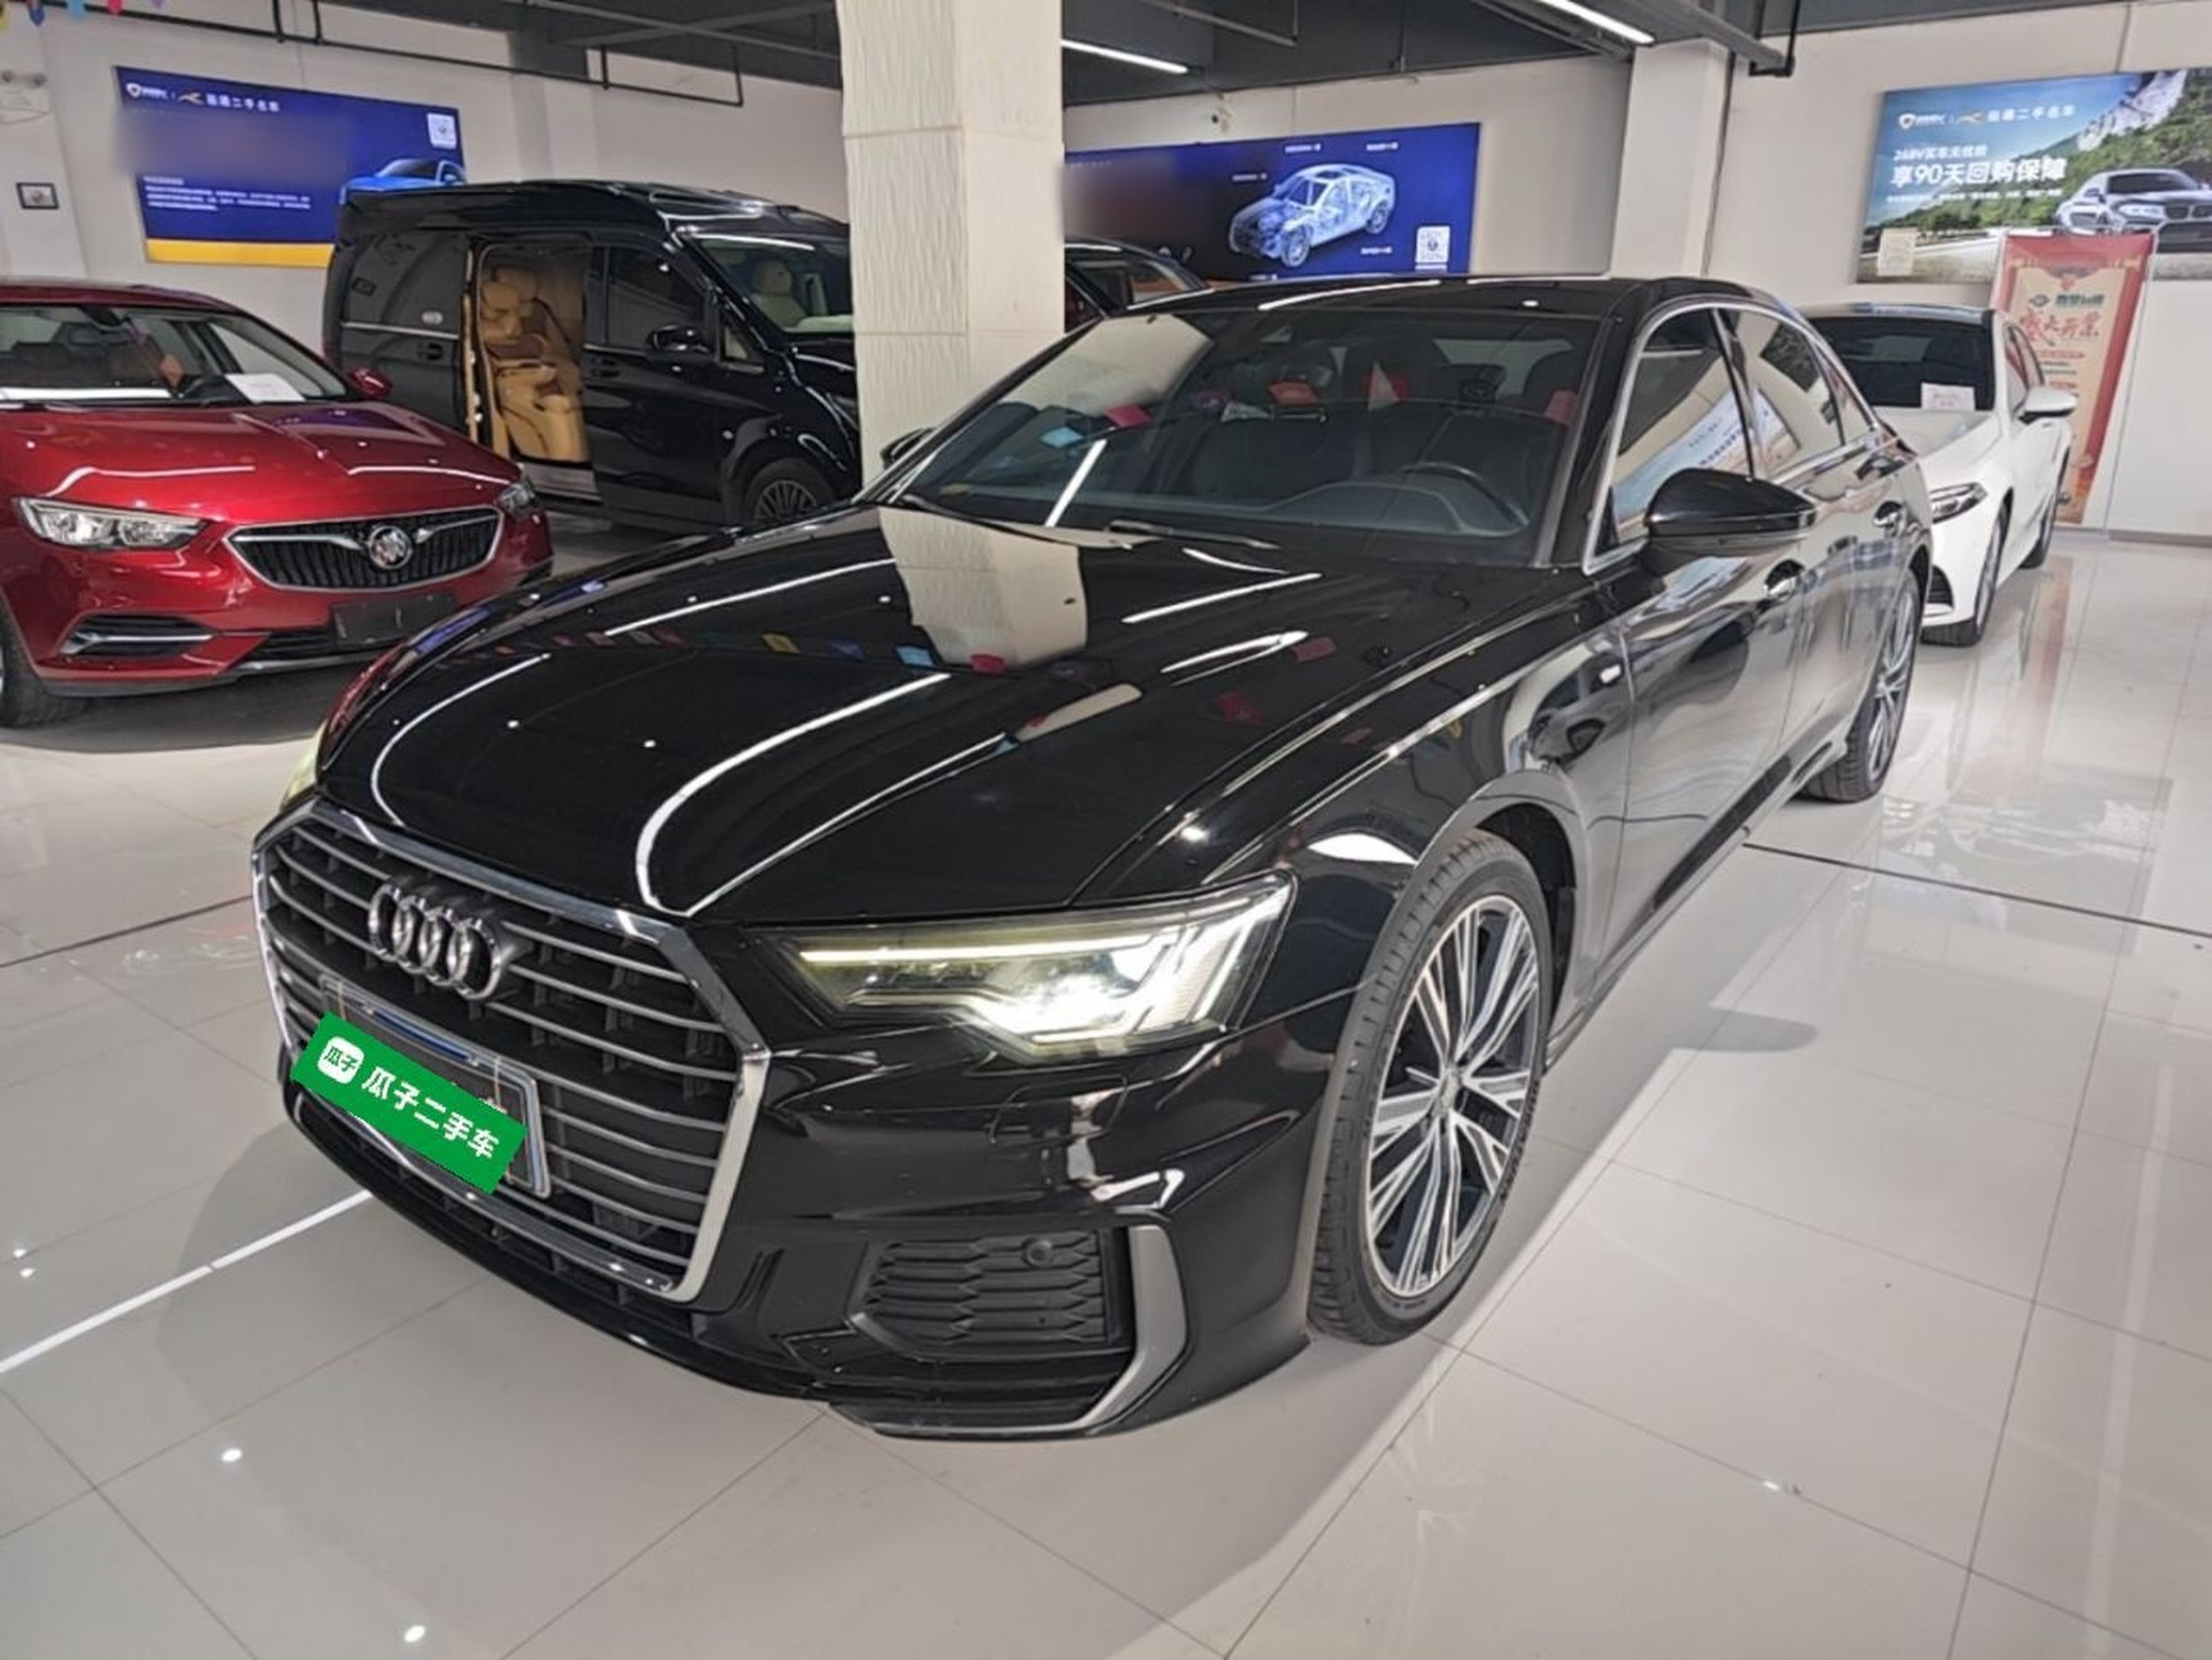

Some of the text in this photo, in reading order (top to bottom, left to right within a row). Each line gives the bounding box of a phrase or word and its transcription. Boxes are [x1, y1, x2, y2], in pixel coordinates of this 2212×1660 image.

[1891, 156, 2067, 188] 享90天回购保障
